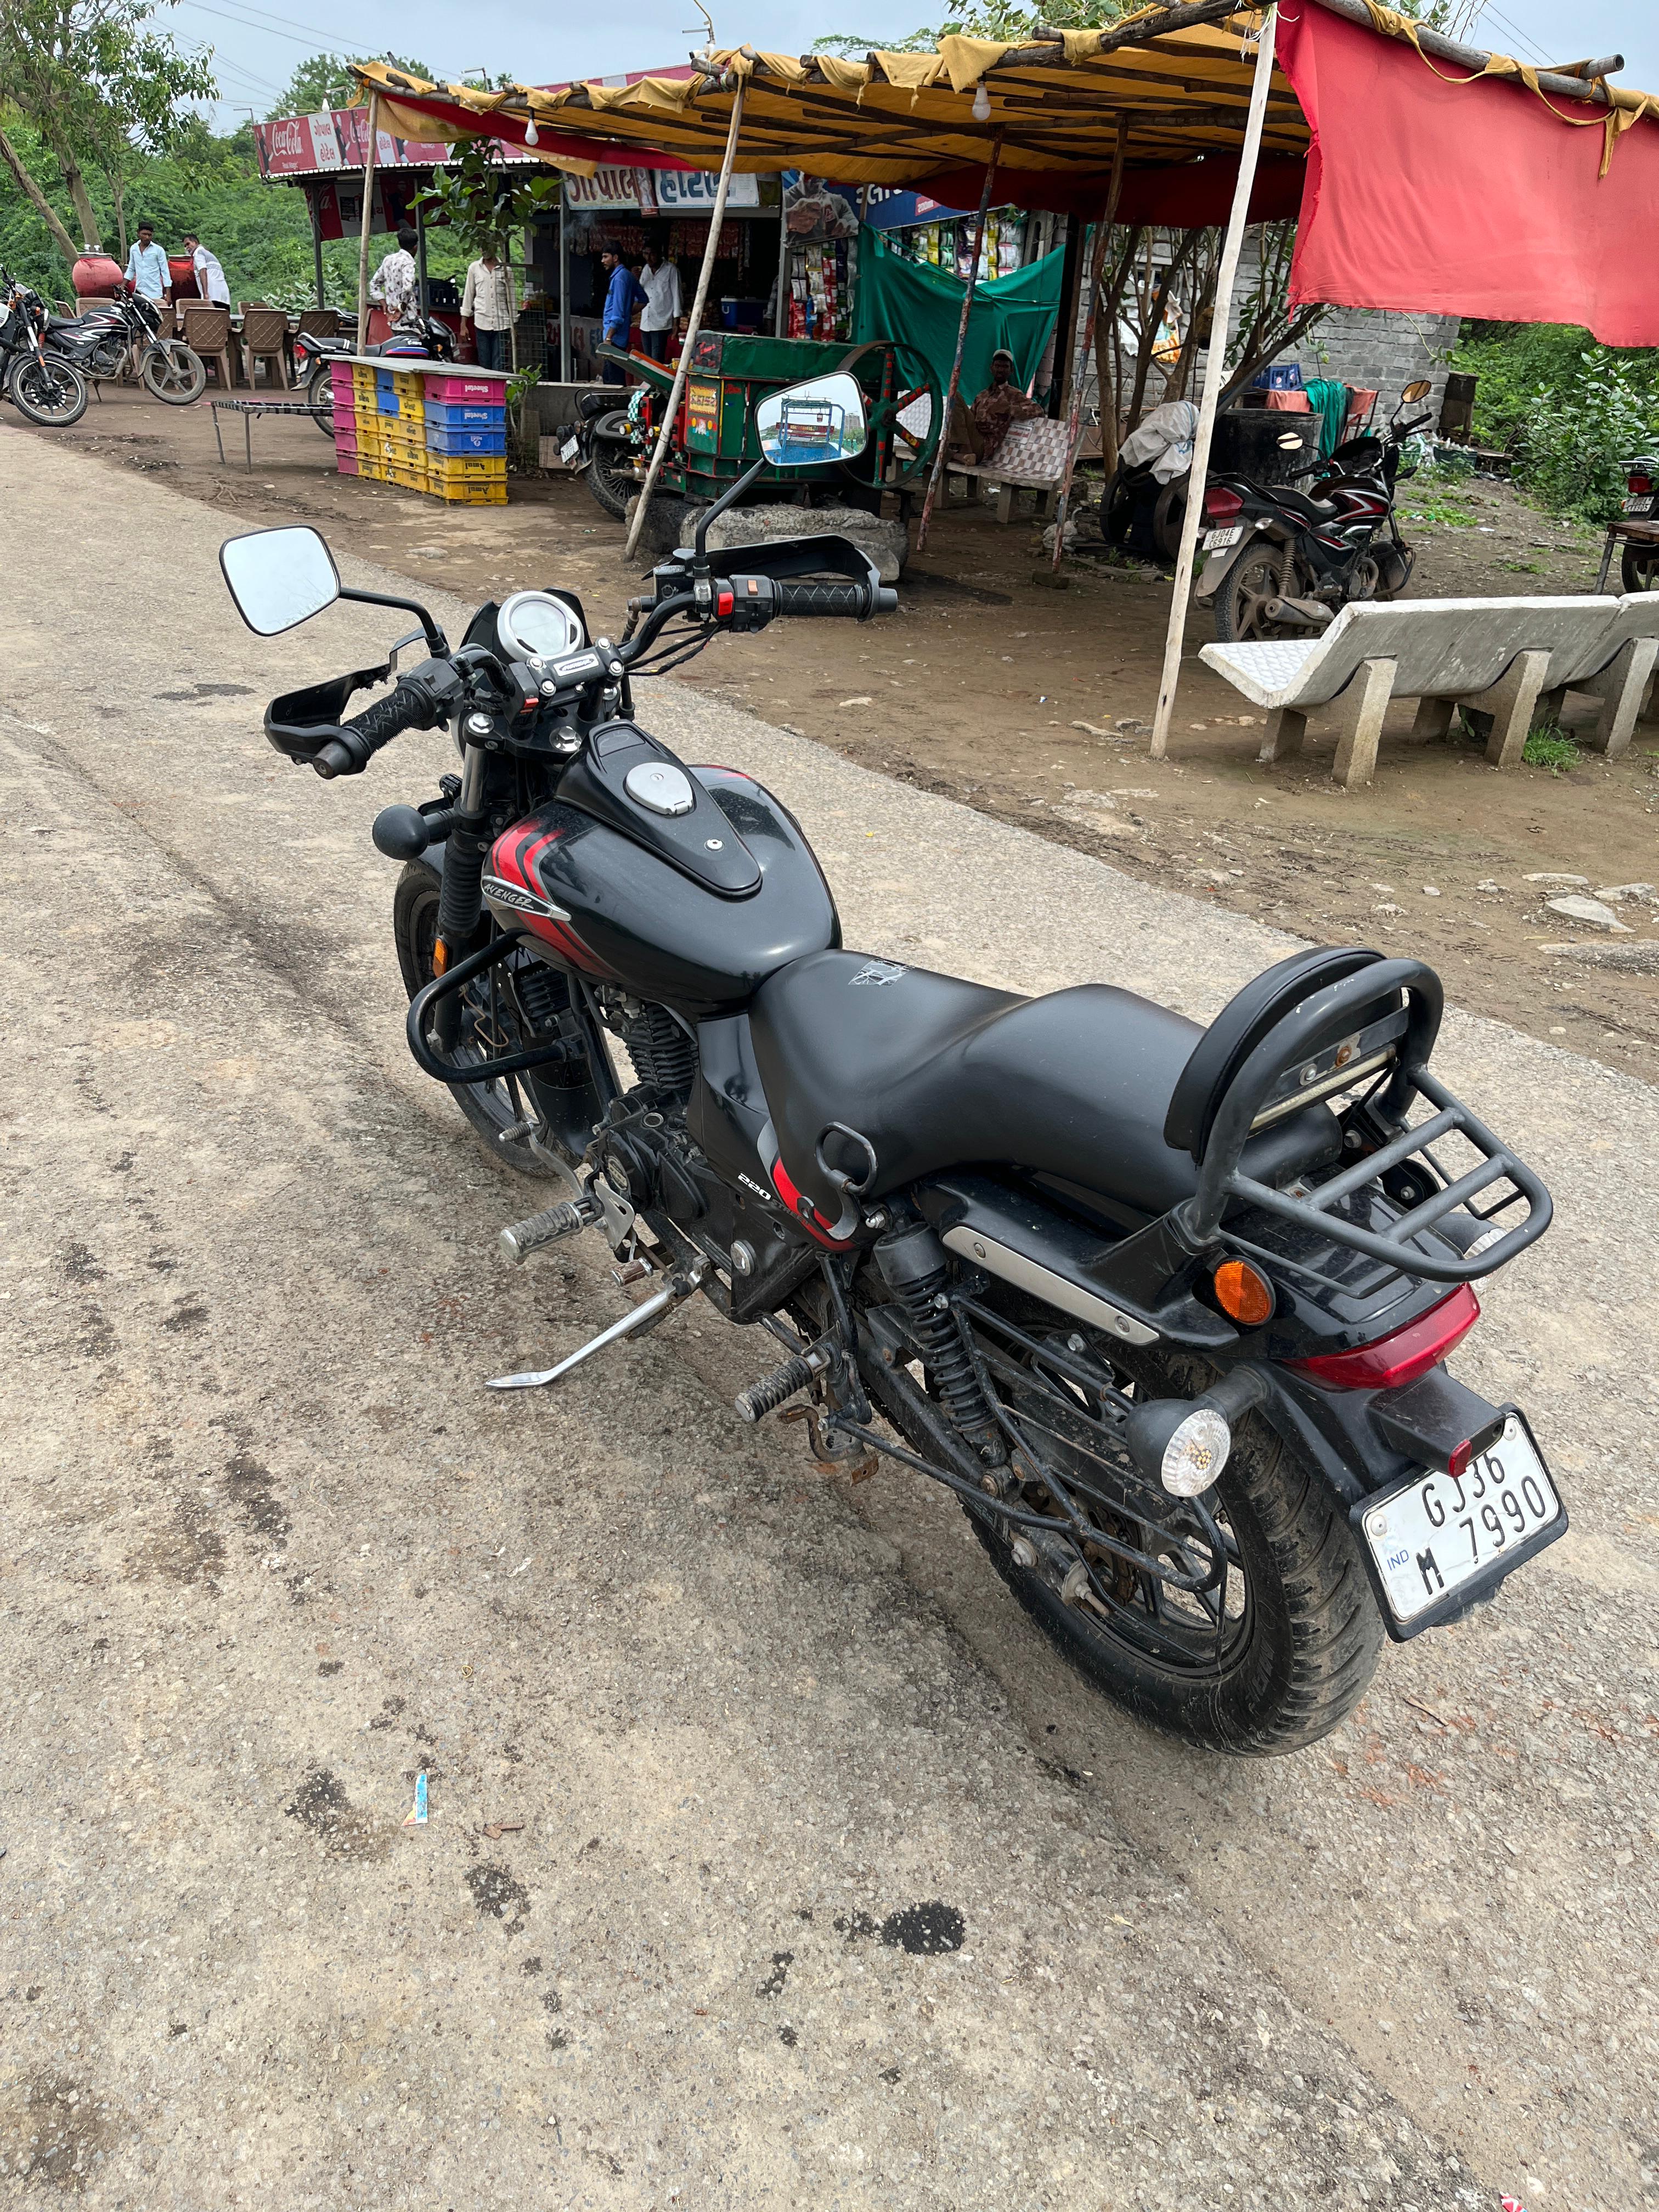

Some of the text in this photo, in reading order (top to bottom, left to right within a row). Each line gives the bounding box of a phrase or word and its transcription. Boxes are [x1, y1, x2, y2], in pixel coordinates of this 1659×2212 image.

[484, 883, 534, 910] AVENGER
[737, 1172, 771, 1201] 220
[1421, 1452, 1505, 1527] GJ36
[1416, 1476, 1546, 1595] M 7990
[1387, 1549, 1409, 1571] IND
